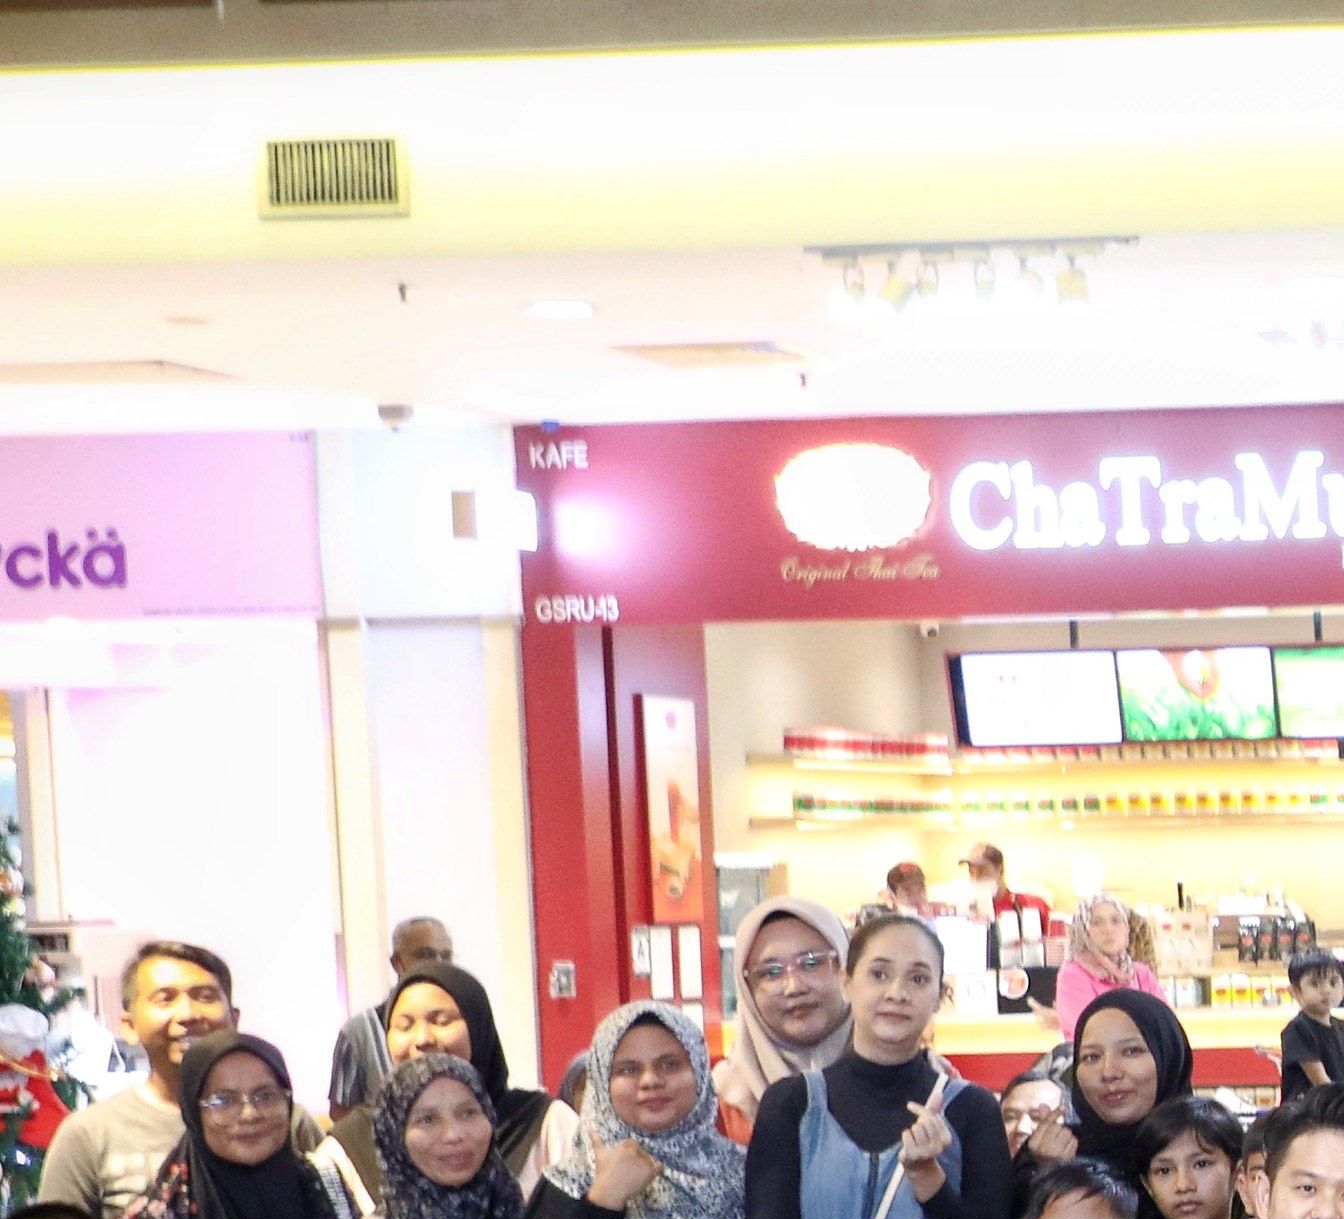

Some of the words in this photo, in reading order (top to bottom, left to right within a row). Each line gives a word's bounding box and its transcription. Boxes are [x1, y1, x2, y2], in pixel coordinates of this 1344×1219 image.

[529, 440, 589, 471] KAFE
[0, 526, 127, 590] ckä
[780, 556, 852, 590] Original
